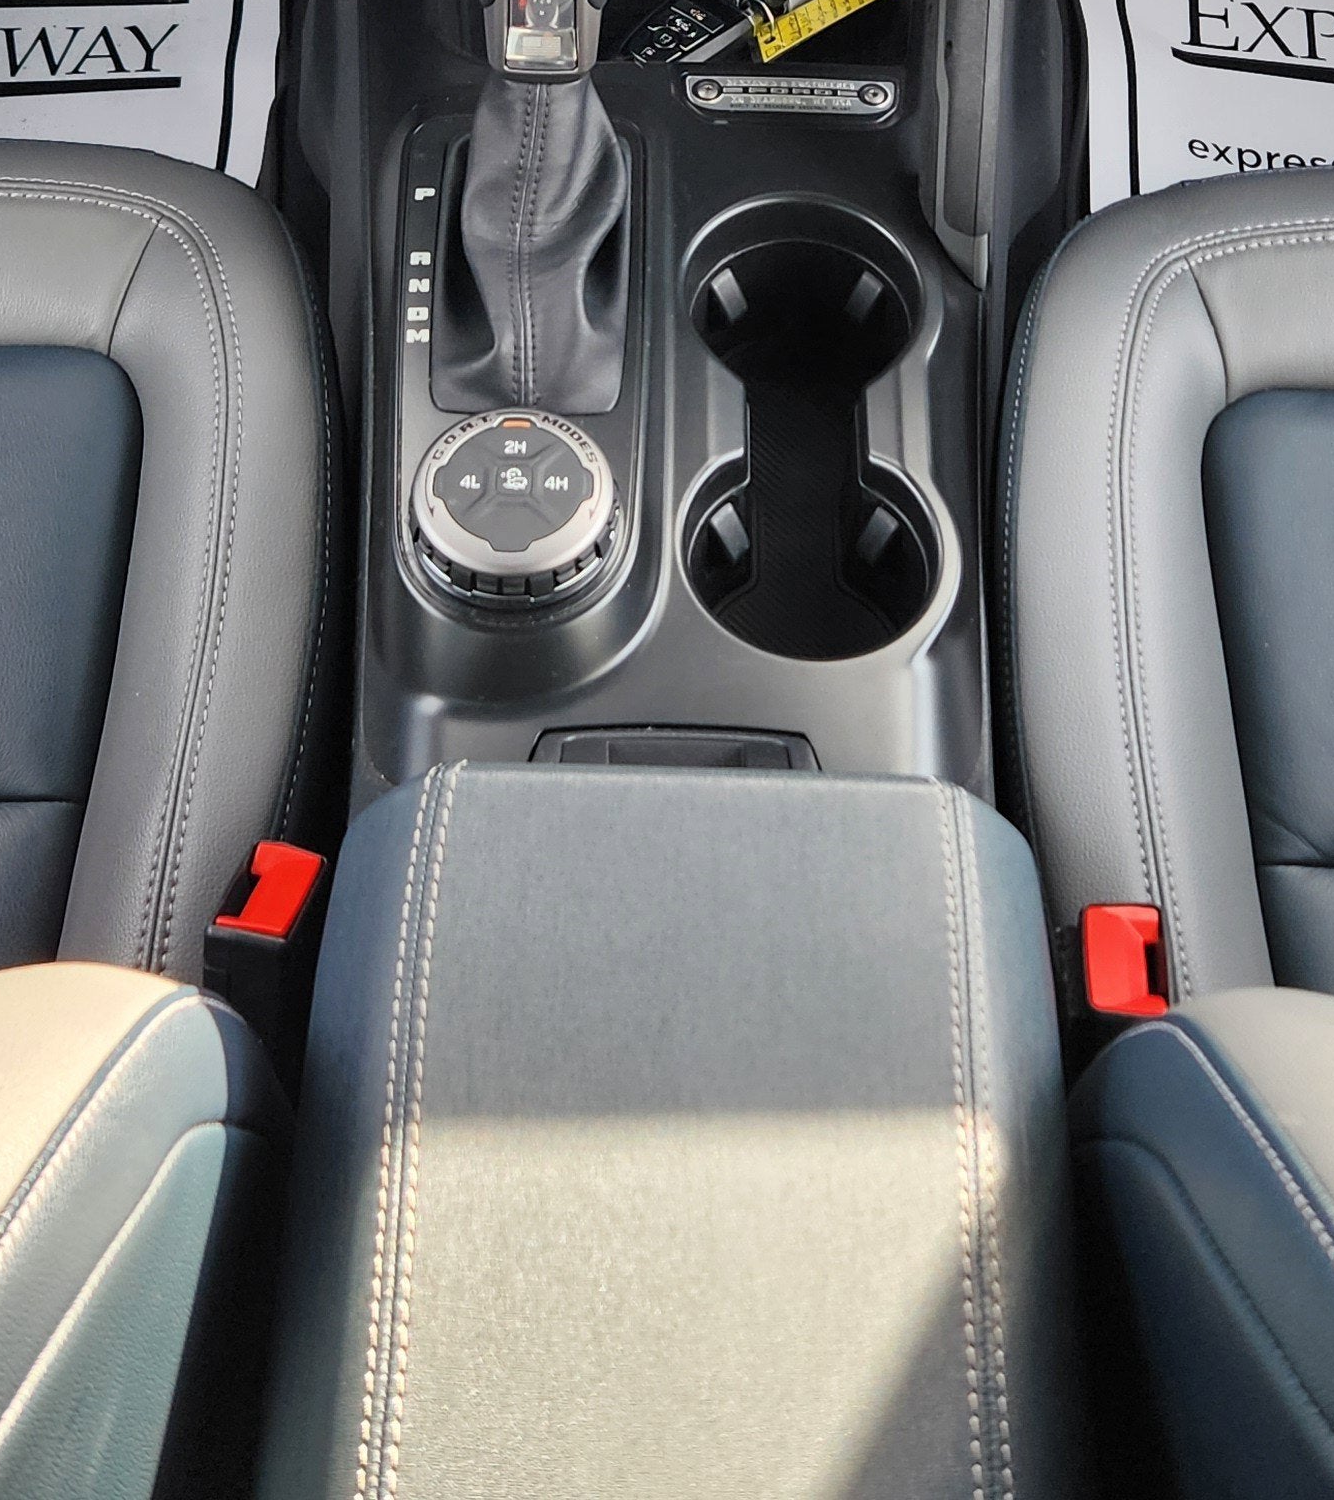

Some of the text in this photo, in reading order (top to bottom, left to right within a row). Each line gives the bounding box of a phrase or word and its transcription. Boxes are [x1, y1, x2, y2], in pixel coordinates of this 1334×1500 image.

[415, 188, 436, 200] P
[408, 278, 430, 293] N
[406, 329, 430, 343] M
[541, 415, 599, 463] MODES
[504, 440, 527, 454] 2H
[459, 474, 480, 489] 4L
[544, 476, 569, 491] 4H
